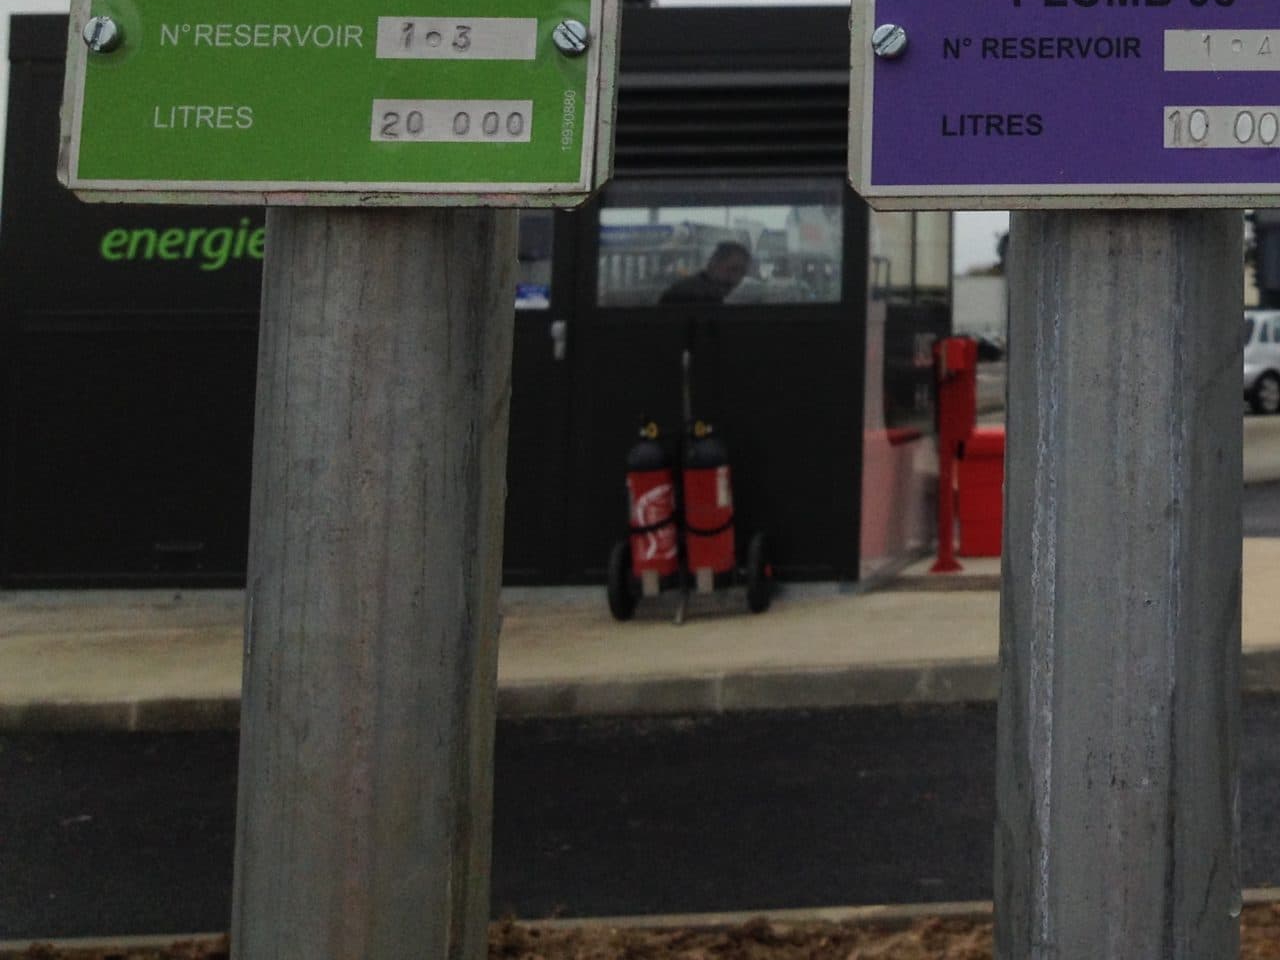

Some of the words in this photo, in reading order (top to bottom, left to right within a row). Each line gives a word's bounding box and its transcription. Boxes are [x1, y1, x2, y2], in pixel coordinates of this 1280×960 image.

[943, 37, 972, 60] N°
[982, 36, 1142, 60] RESERVOIR
[153, 104, 254, 129] LITRES
[941, 113, 1044, 137] LITRES
[100, 216, 266, 271] energie
